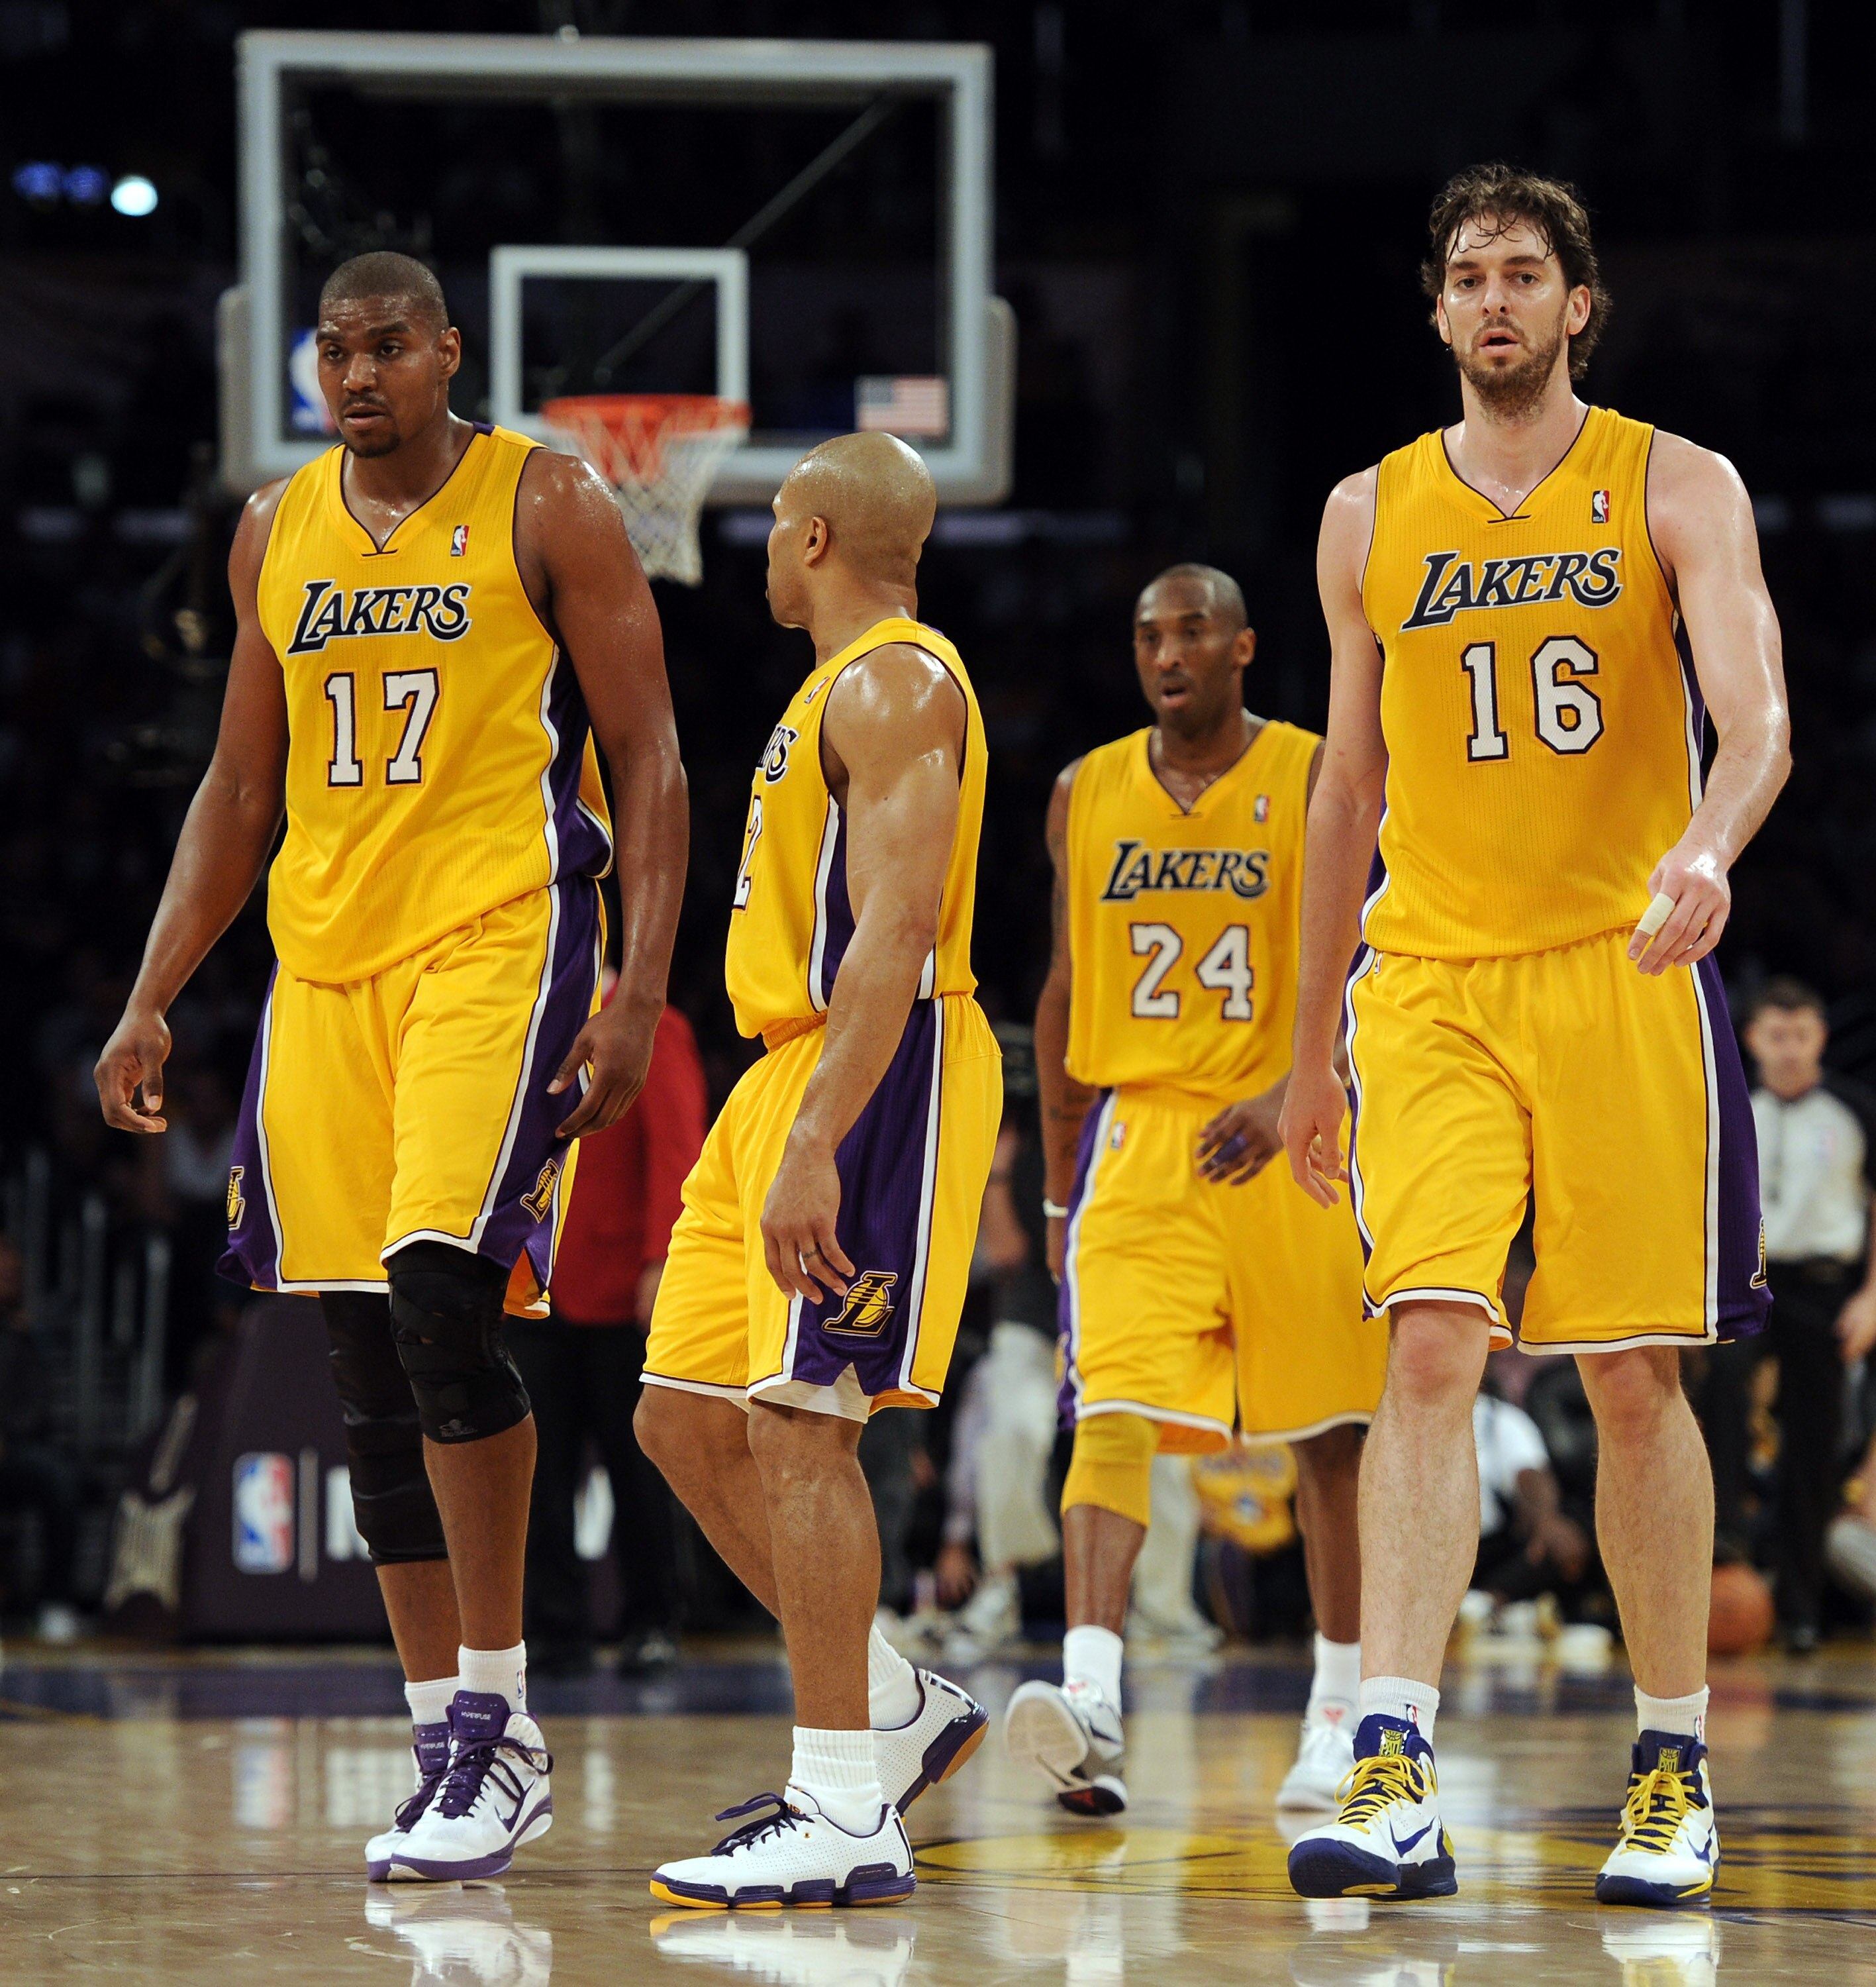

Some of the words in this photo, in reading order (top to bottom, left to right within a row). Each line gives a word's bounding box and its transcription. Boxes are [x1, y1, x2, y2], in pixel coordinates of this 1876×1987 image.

[286, 579, 473, 658] LAKERS
[1399, 546, 1624, 633] LAKERS
[324, 667, 440, 787] 17
[1460, 635, 1605, 762] 16
[1099, 838, 1270, 903] LAKERS
[1128, 922, 1254, 1021] 24
